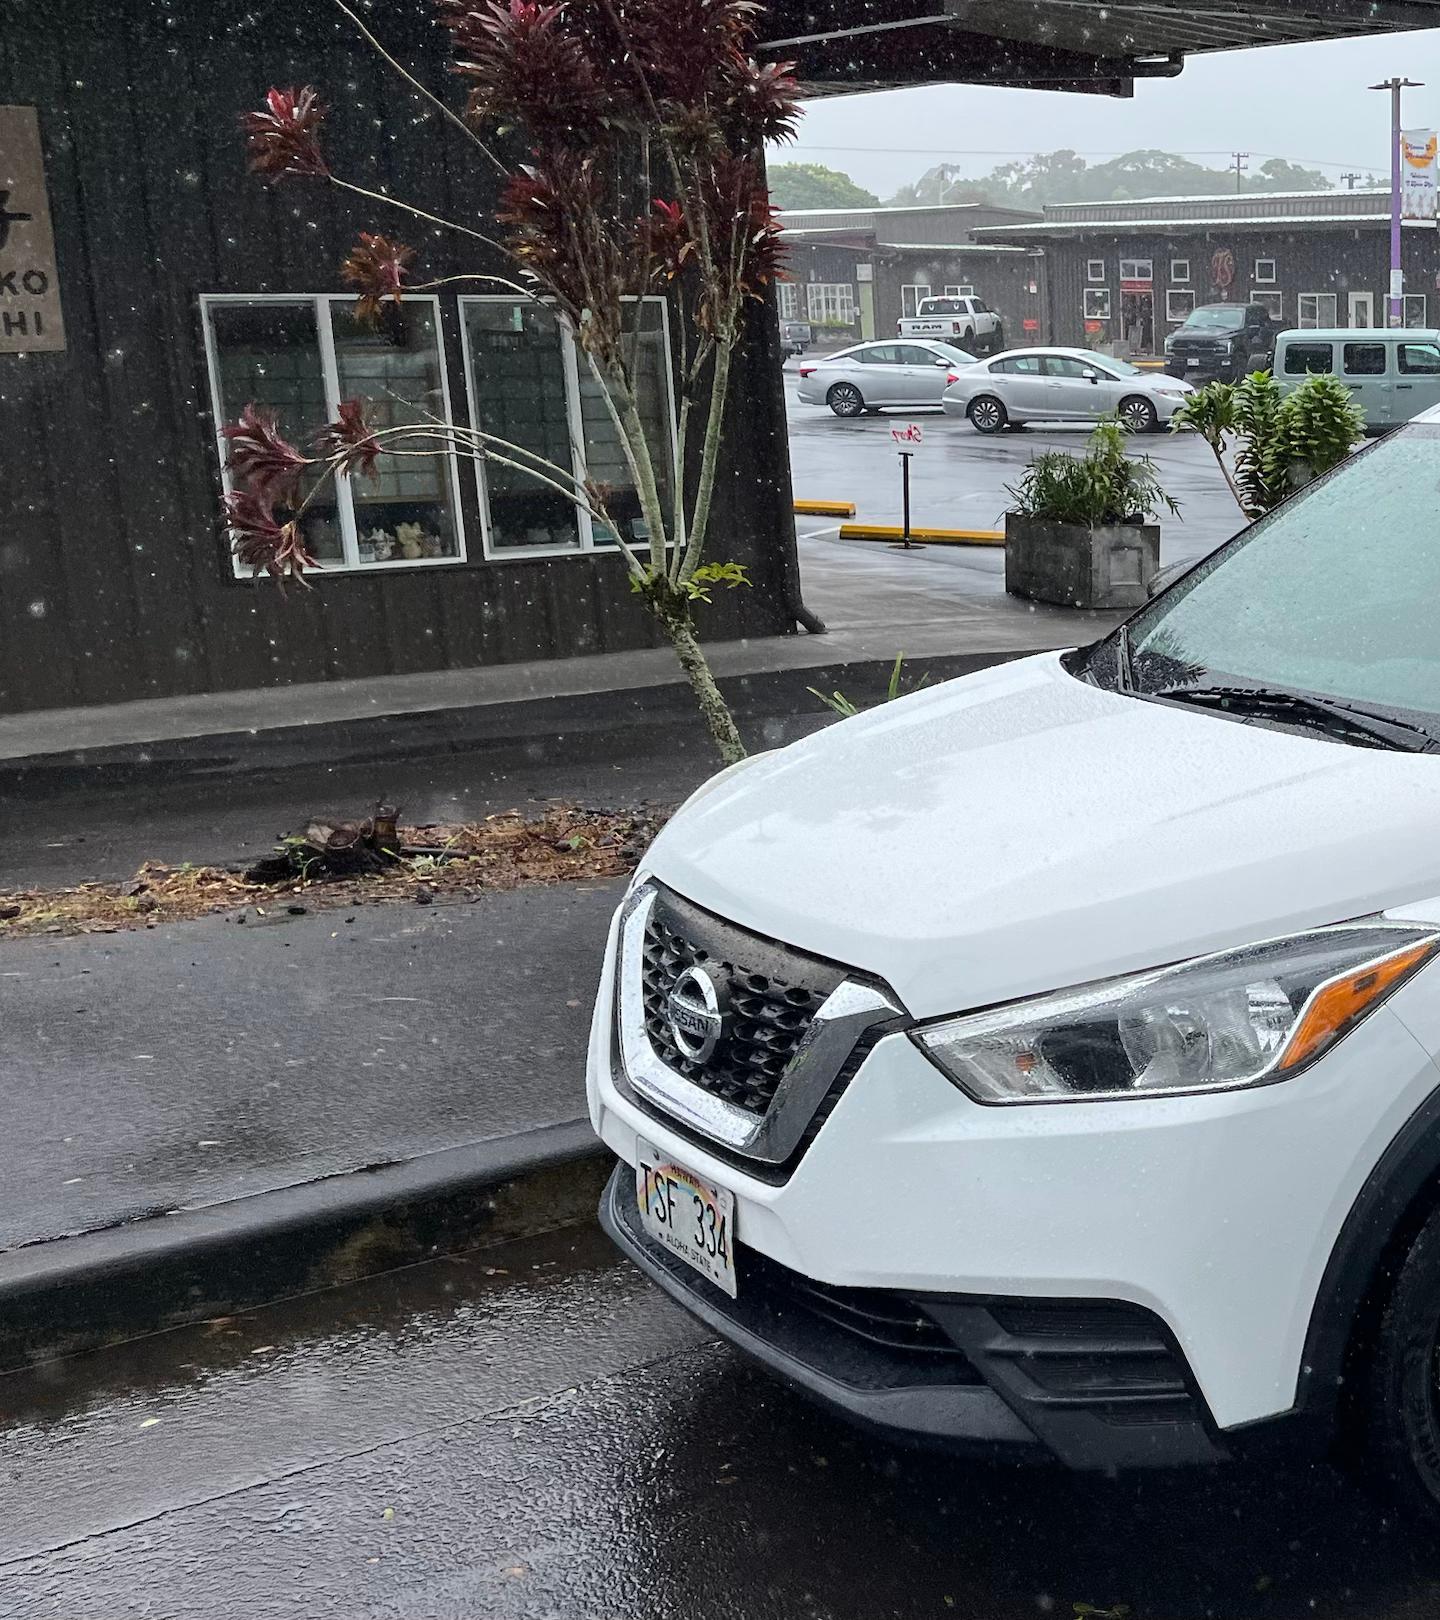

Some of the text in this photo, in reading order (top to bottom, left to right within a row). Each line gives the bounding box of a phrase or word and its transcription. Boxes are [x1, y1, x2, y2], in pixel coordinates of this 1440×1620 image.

[639, 1161, 729, 1270] TSF 334
[666, 1232, 712, 1273] ALOHA STATE
